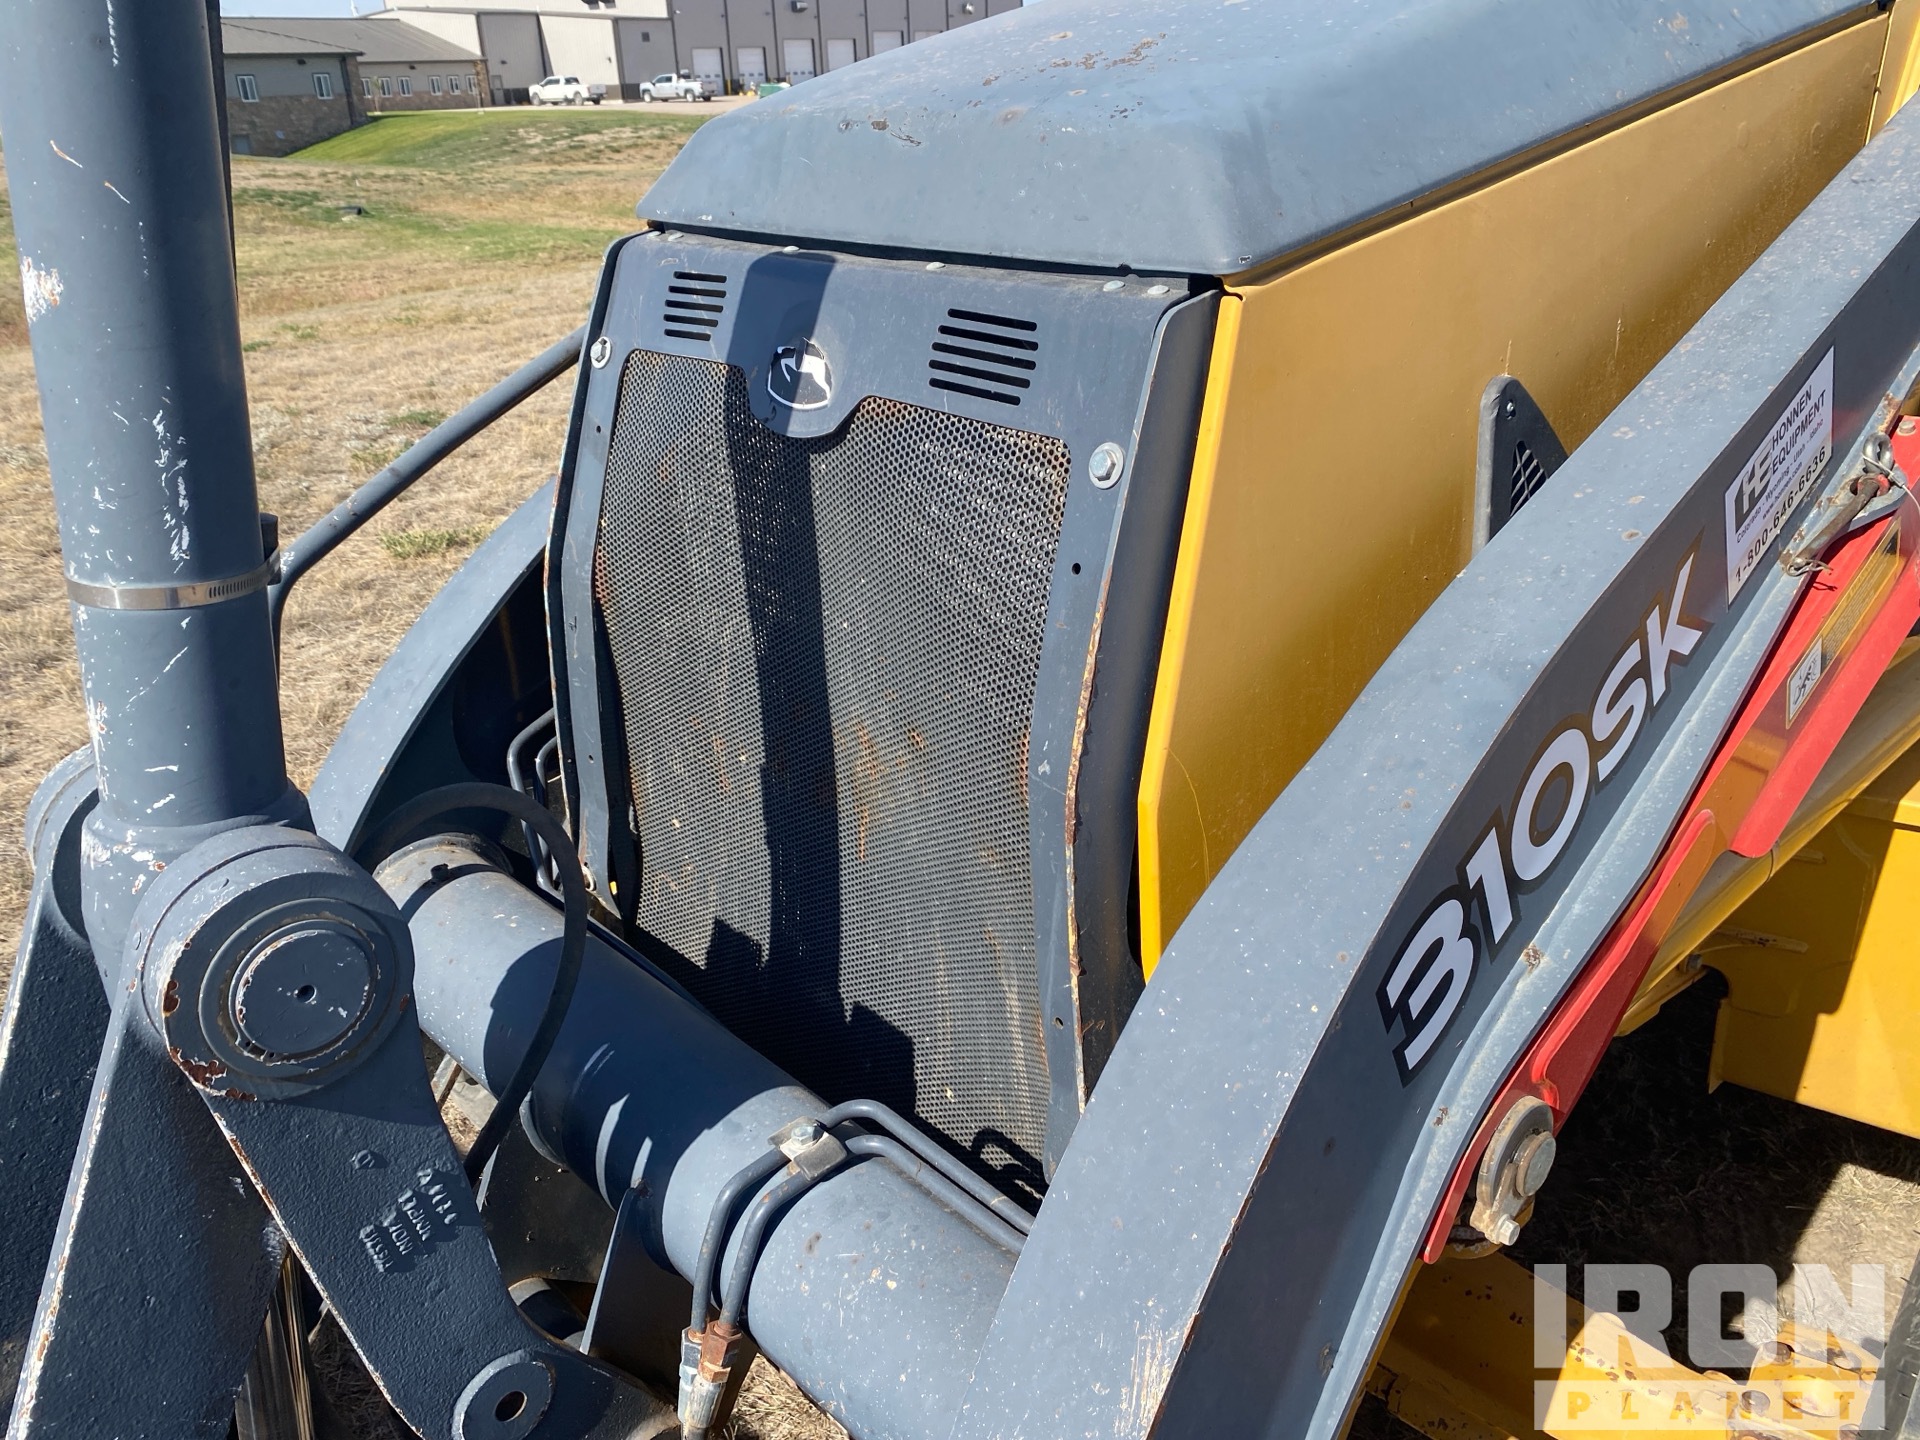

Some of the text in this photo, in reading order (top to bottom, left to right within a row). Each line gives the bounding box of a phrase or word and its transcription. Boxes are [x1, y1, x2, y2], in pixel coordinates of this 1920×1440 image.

[1772, 385, 1812, 451] HONNEN
[1772, 389, 1826, 475] EQUIPMENT
[1735, 446, 1826, 583] 1-800-646-6636
[1737, 507, 1761, 543] Colorado
[1765, 466, 1790, 502] Wyoming
[1386, 551, 1703, 1071] 310SK
